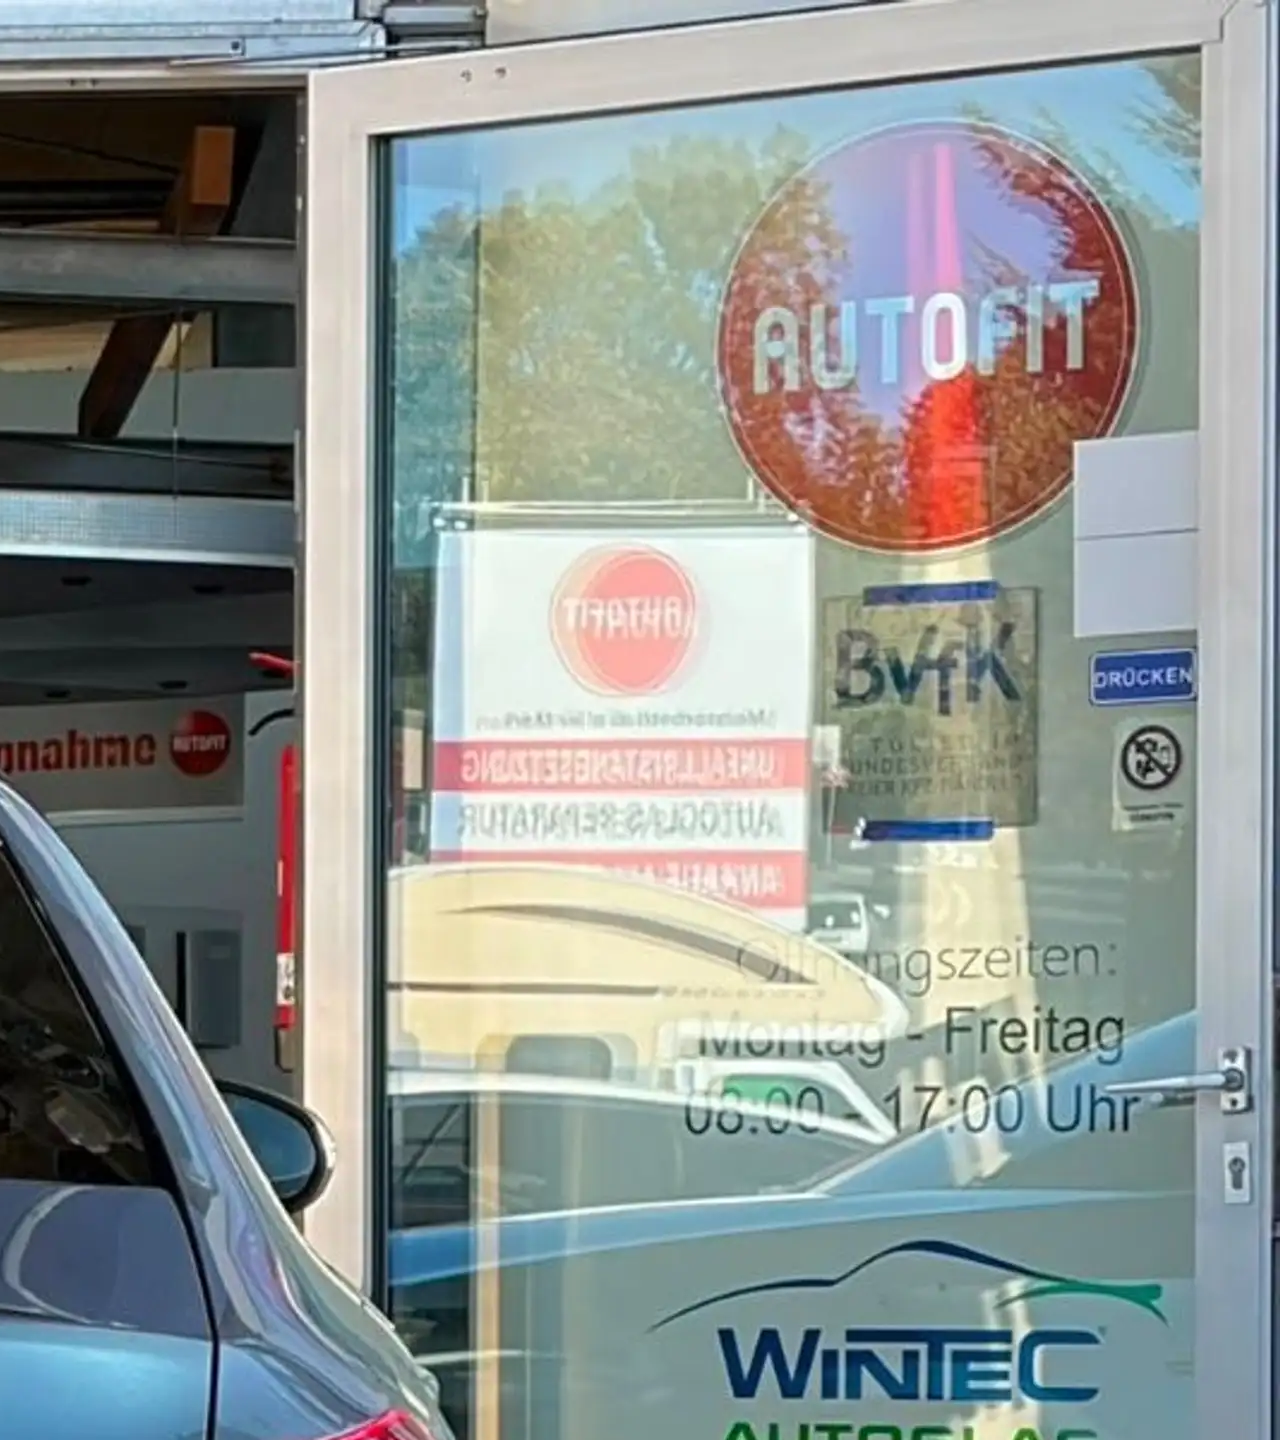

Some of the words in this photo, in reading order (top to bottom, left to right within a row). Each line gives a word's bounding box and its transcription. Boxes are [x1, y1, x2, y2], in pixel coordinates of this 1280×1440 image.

[751, 278, 1100, 396] AUTOFIT
[1093, 666, 1192, 688] DRÜCKEN
[945, 1004, 1125, 1065] Freitag
[883, 1084, 1024, 1135] 17:00
[1045, 1083, 1142, 1134] Uhr
